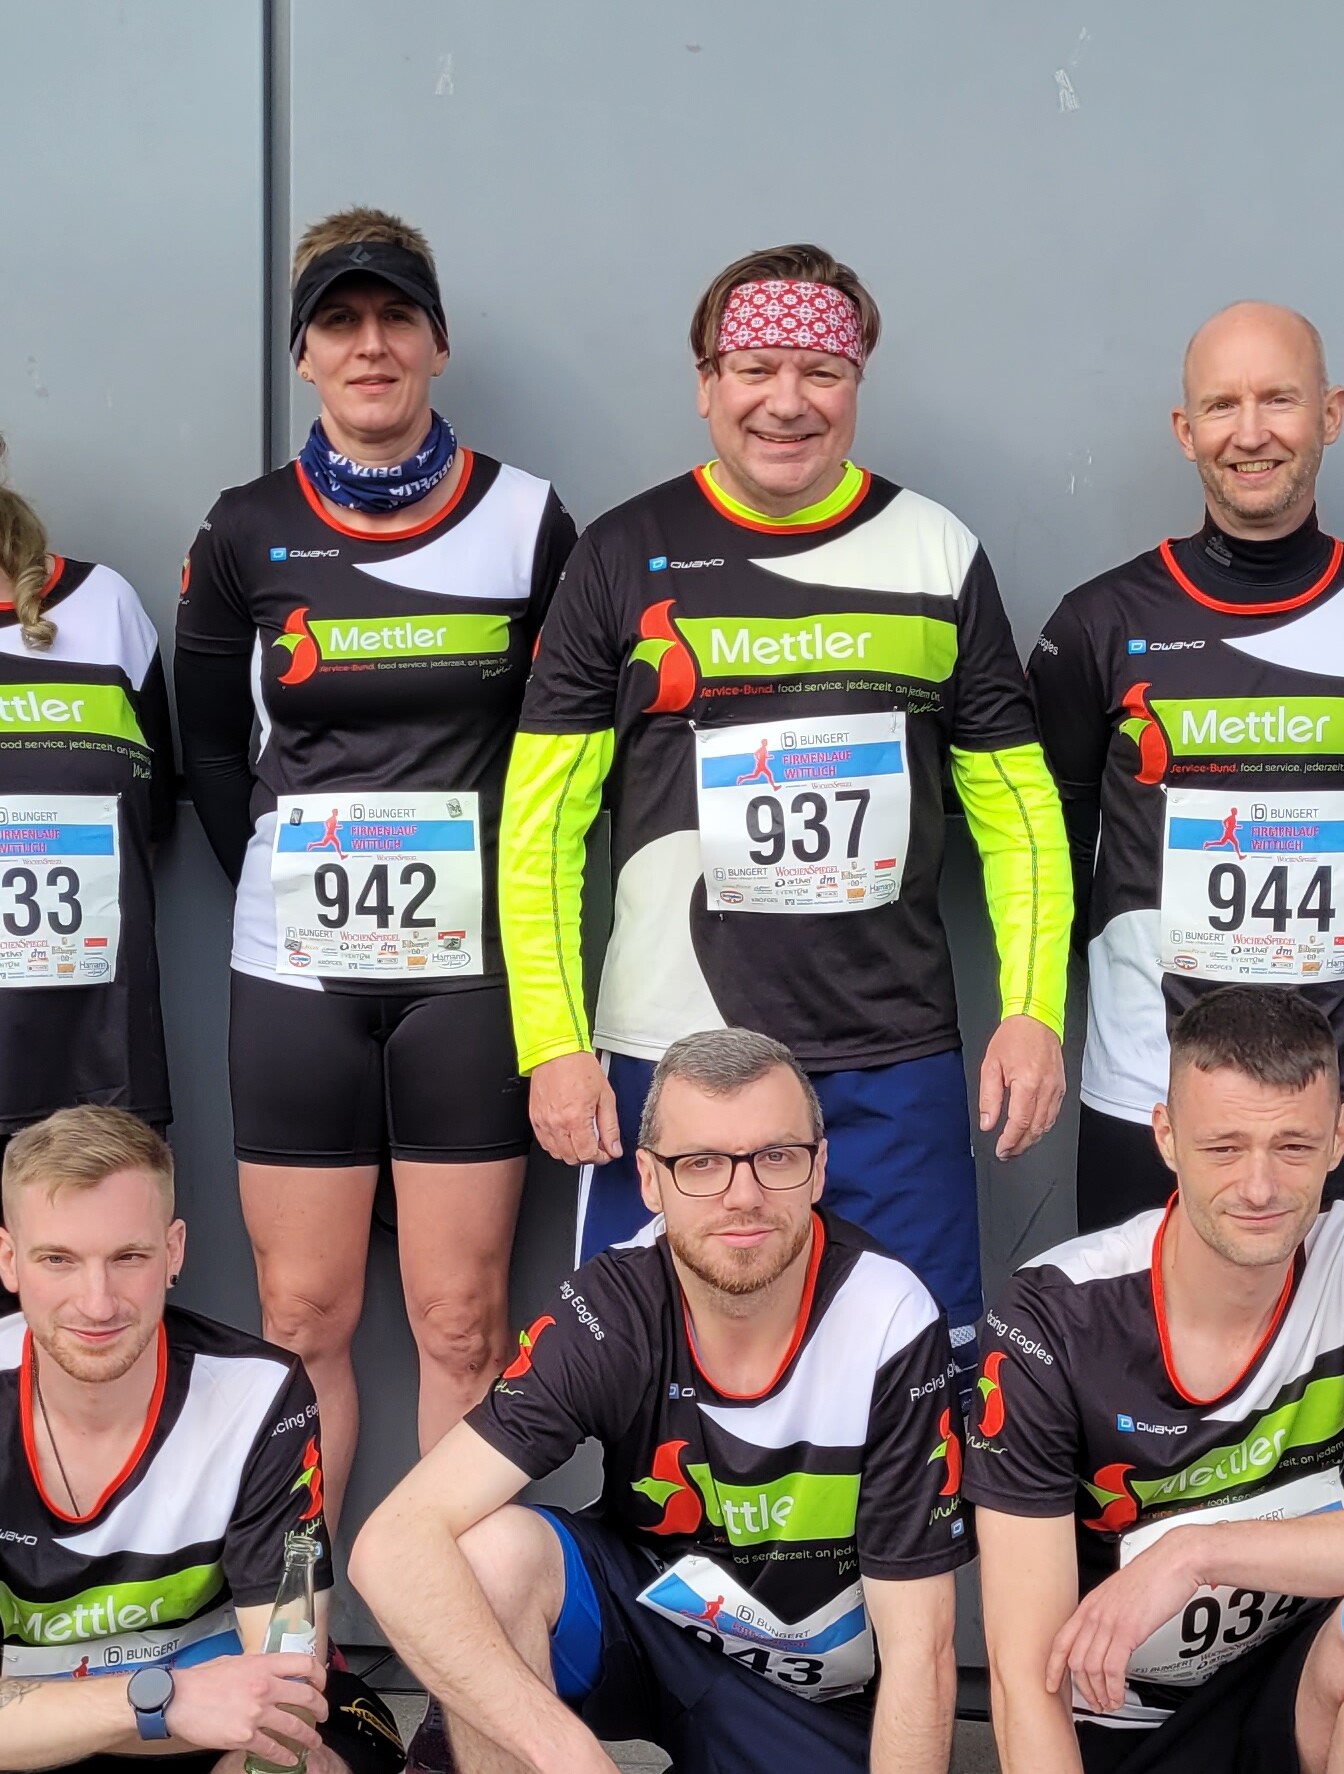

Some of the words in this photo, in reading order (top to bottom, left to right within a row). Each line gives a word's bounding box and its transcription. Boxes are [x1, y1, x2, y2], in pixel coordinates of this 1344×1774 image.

[289, 549, 340, 558] owayo
[670, 558, 725, 569] owayo
[329, 623, 447, 653] Mettler
[711, 623, 871, 665] Mettler
[1149, 640, 1205, 651] owayo
[777, 683, 802, 694] food
[804, 682, 844, 692] service.
[895, 686, 906, 694] an
[1182, 706, 1330, 745] Mettler
[24, 740, 67, 749] service.
[800, 732, 850, 745] BUNGERT
[783, 750, 852, 765] FIRMENLAUF
[785, 766, 837, 779] WITTLICH
[1240, 763, 1263, 772] food
[1265, 763, 1302, 772] service.
[12, 812, 58, 822] BUNGERT
[369, 809, 416, 818] BUNGERT
[1271, 809, 1318, 818] BUNGERT
[351, 826, 417, 836] FIRMENLAUF
[746, 789, 870, 865] 937
[1251, 825, 1319, 836] FIRMENLAUF
[352, 840, 401, 849] WITTLICH
[1251, 840, 1303, 850] WITTLICH
[728, 868, 768, 877] BUNGERT
[314, 862, 436, 929] 942
[1208, 862, 1336, 932] 944
[299, 929, 334, 939] BUNGERT
[1186, 932, 1225, 942] BUNGERT
[571, 1295, 605, 1341] Eagles
[1009, 1328, 1054, 1365] Eagles
[1136, 1422, 1188, 1435] owayo
[1300, 1455, 1314, 1464] an
[1317, 1441, 1344, 1462] jedem
[815, 1551, 831, 1559] an
[13, 1595, 164, 1643] Mettler
[757, 1618, 811, 1638] BUNGERT
[126, 1639, 179, 1661] BUNGERT
